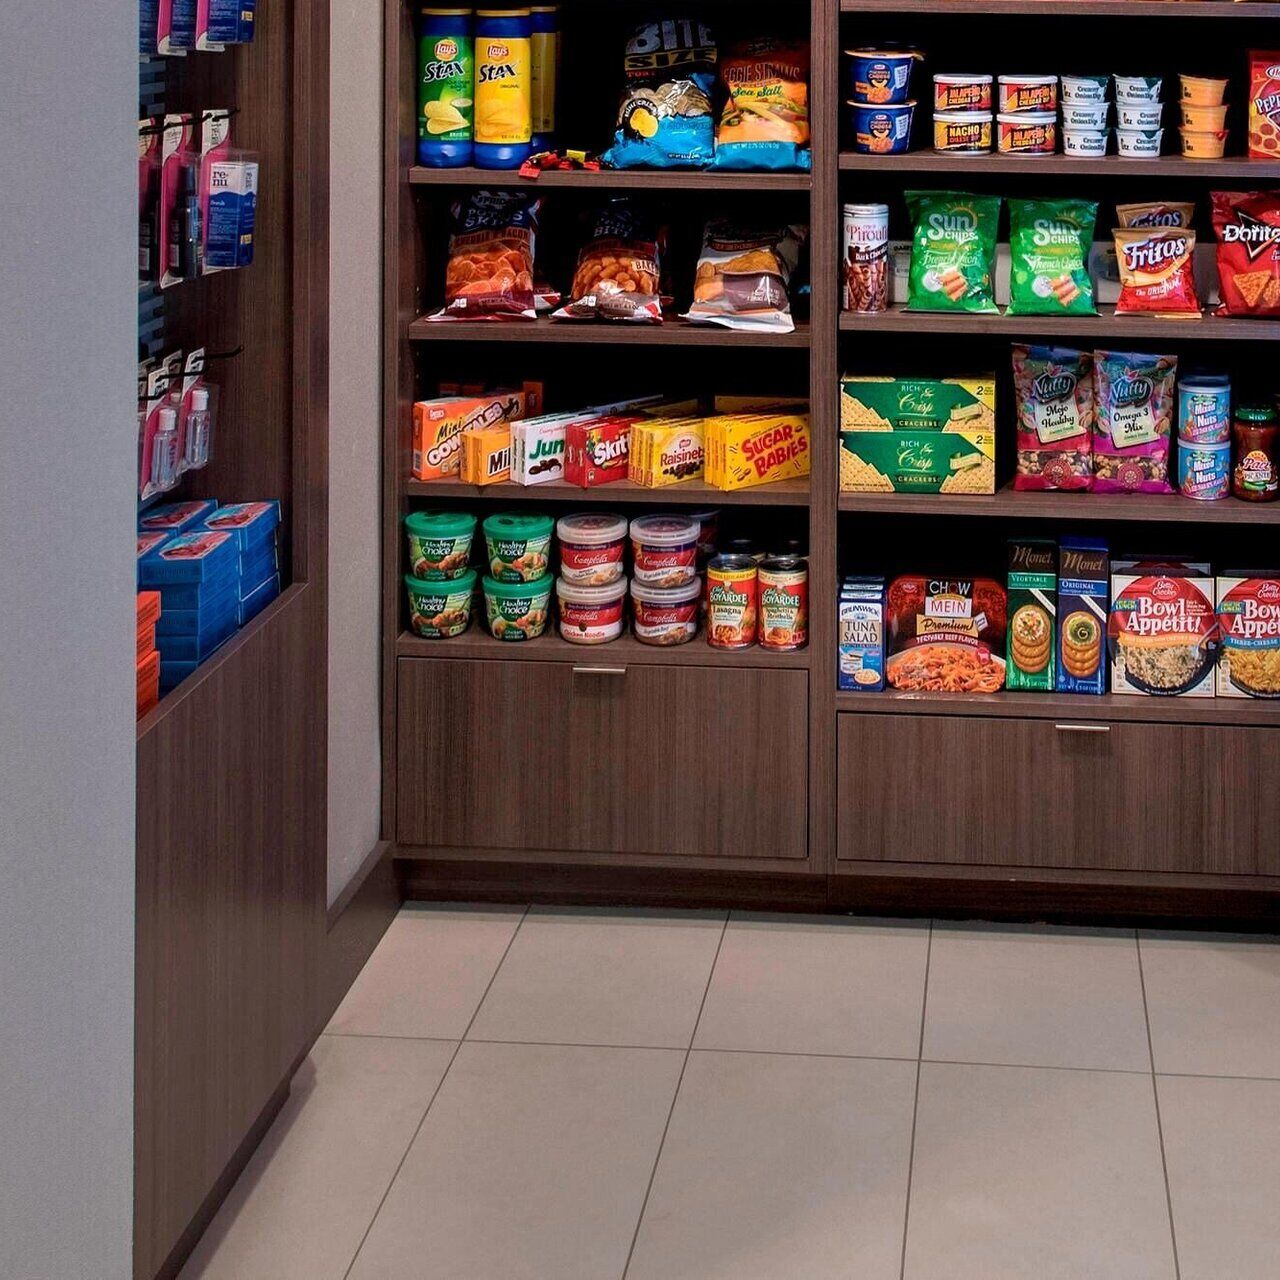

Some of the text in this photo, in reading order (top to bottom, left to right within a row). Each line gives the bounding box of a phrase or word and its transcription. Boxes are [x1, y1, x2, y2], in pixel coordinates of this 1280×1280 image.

[625, 19, 716, 55] BITE
[625, 48, 718, 71] SIZE
[755, 62, 801, 81] STRAWS
[732, 85, 783, 99] Sea Salt
[1077, 85, 1100, 93] Creamy
[1019, 98, 1041, 106] CHEDDAR
[1072, 111, 1095, 119] Creamy
[949, 125, 980, 137] NACHO
[212, 179, 228, 187] nu
[927, 214, 970, 240] Sun
[945, 231, 979, 243] CHIPS
[855, 252, 870, 261] Dark
[924, 250, 955, 265] French
[1123, 237, 1187, 271] Fritos
[1031, 255, 1060, 271] French
[976, 385, 984, 395] 2
[1034, 376, 1072, 393] Nutty
[920, 387, 933, 398] &
[1111, 382, 1149, 400] Nutty
[897, 393, 935, 415] Crisp
[1046, 403, 1069, 417] Mojo
[1195, 403, 1216, 415] Mixed
[1041, 415, 1075, 428] Healthy
[1113, 408, 1149, 423] Omega 3
[1197, 415, 1218, 428] Nuts
[437, 416, 463, 442] Mini
[1124, 423, 1144, 434] Mix
[740, 423, 795, 463] SUGAR
[975, 435, 983, 445] 2
[920, 443, 933, 453] &
[752, 436, 810, 478] BABIES
[897, 448, 934, 471] Crisp
[1193, 459, 1215, 472] Mixed
[1196, 471, 1216, 484] Nuts
[421, 547, 451, 555] Choice
[424, 541, 454, 550] Healthy
[496, 547, 525, 556] Choice
[498, 541, 526, 550] Healthy
[573, 554, 608, 566] Campbell's
[1013, 545, 1053, 568] Monet
[643, 557, 678, 569] Campbell's
[1063, 552, 1103, 575] Monet
[1011, 574, 1047, 583] VEGETABLE
[929, 580, 971, 595] CHOW
[1062, 581, 1095, 590] ORIGINAL
[1156, 581, 1175, 590] Betty
[1261, 584, 1280, 593] Betty
[710, 592, 748, 604] BOYARDEE
[1152, 588, 1178, 596] Crocker
[419, 595, 446, 604] Healthy
[503, 598, 531, 608] Healthy
[762, 595, 800, 606] BOYARDEE
[417, 602, 443, 611] Choice
[500, 605, 529, 615] Choice
[713, 607, 742, 615] Lasagna
[841, 604, 880, 618] BRUNSWICK
[931, 600, 967, 614] MEIN
[1139, 597, 1186, 617] Bowl
[566, 610, 598, 621] Campbell's
[643, 612, 678, 624] Campbell's
[845, 621, 877, 632] TUNA
[920, 616, 974, 632] Premium
[1125, 611, 1201, 635] Appétit!
[843, 632, 878, 644] SALAD
[915, 632, 979, 646] TERIYAKI BEEF FLAVOR
[1230, 638, 1279, 646] THREE-CHEESE
